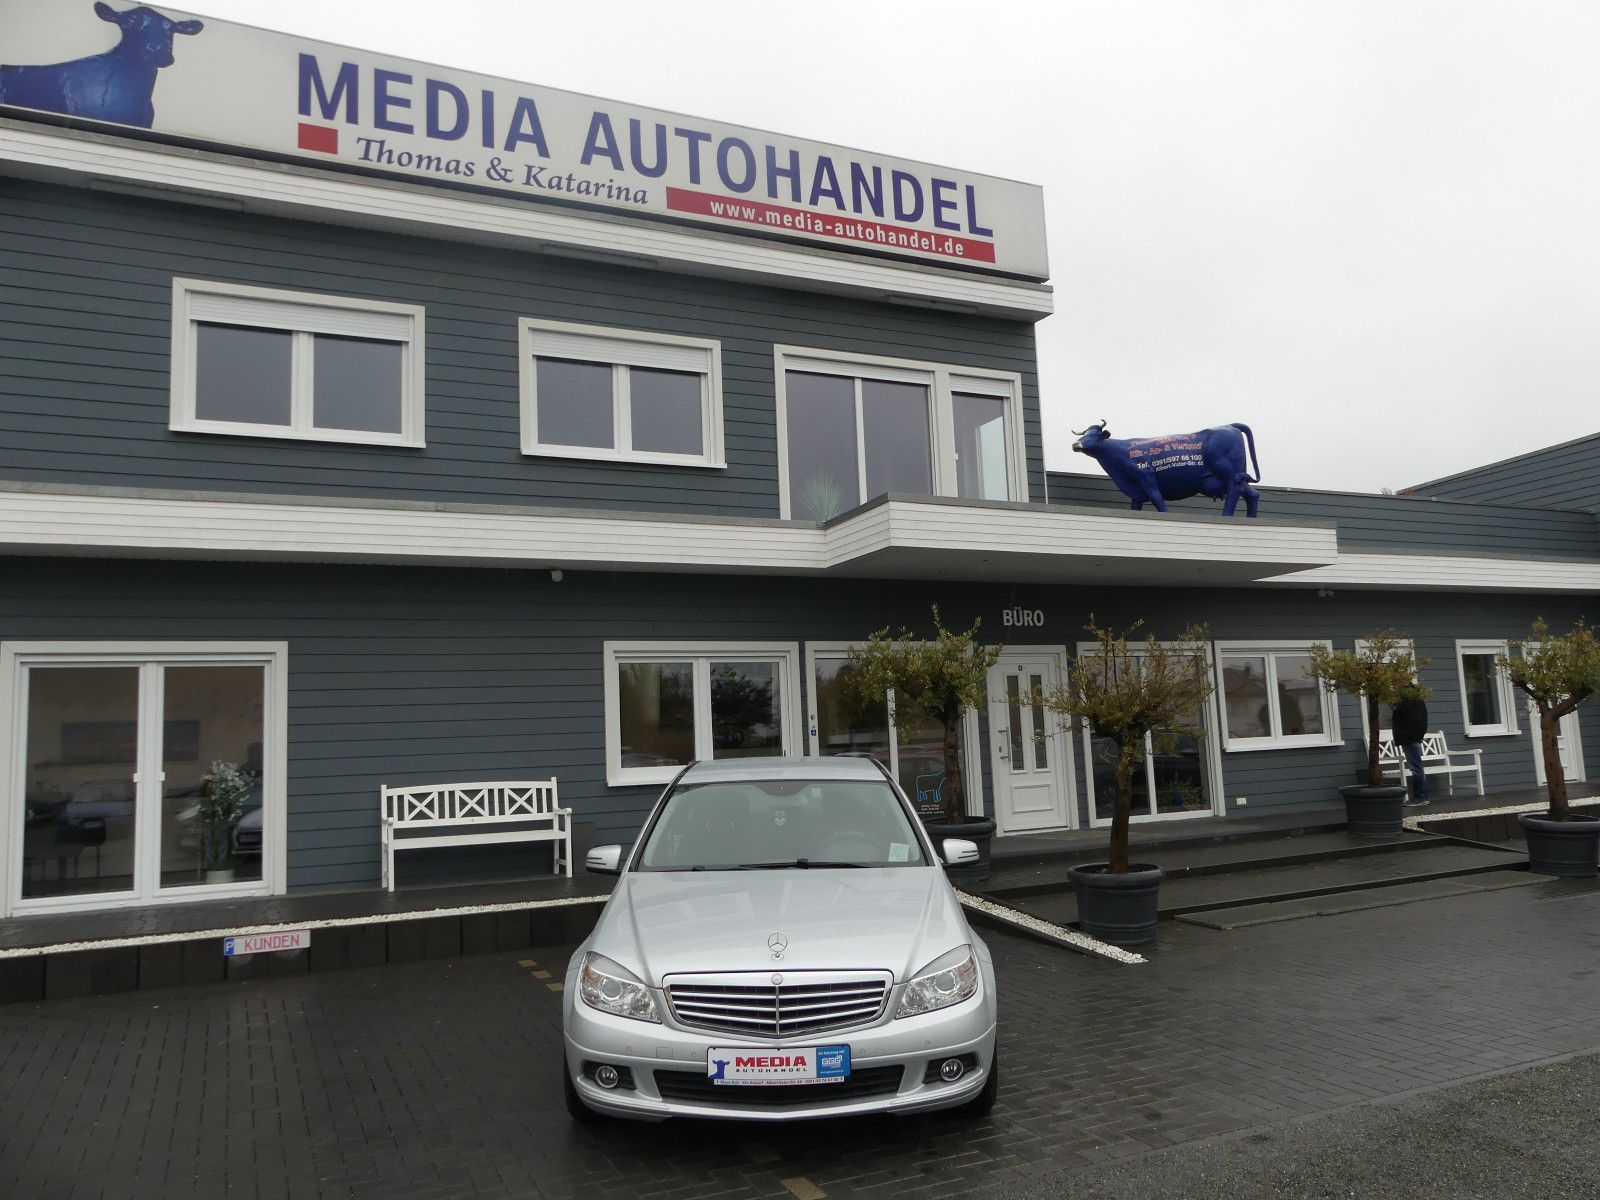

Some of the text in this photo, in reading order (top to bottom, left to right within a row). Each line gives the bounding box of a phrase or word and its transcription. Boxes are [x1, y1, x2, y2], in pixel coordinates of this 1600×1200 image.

[298, 53, 994, 237] MEDIA AUTOHANDEL
[357, 136, 649, 206] Thomas & Katarina
[709, 200, 965, 256] www.media-autohandel.de
[1002, 606, 1045, 627] BÜRO
[244, 934, 300, 952] KUNDEN
[735, 1055, 807, 1068] MEDIA
